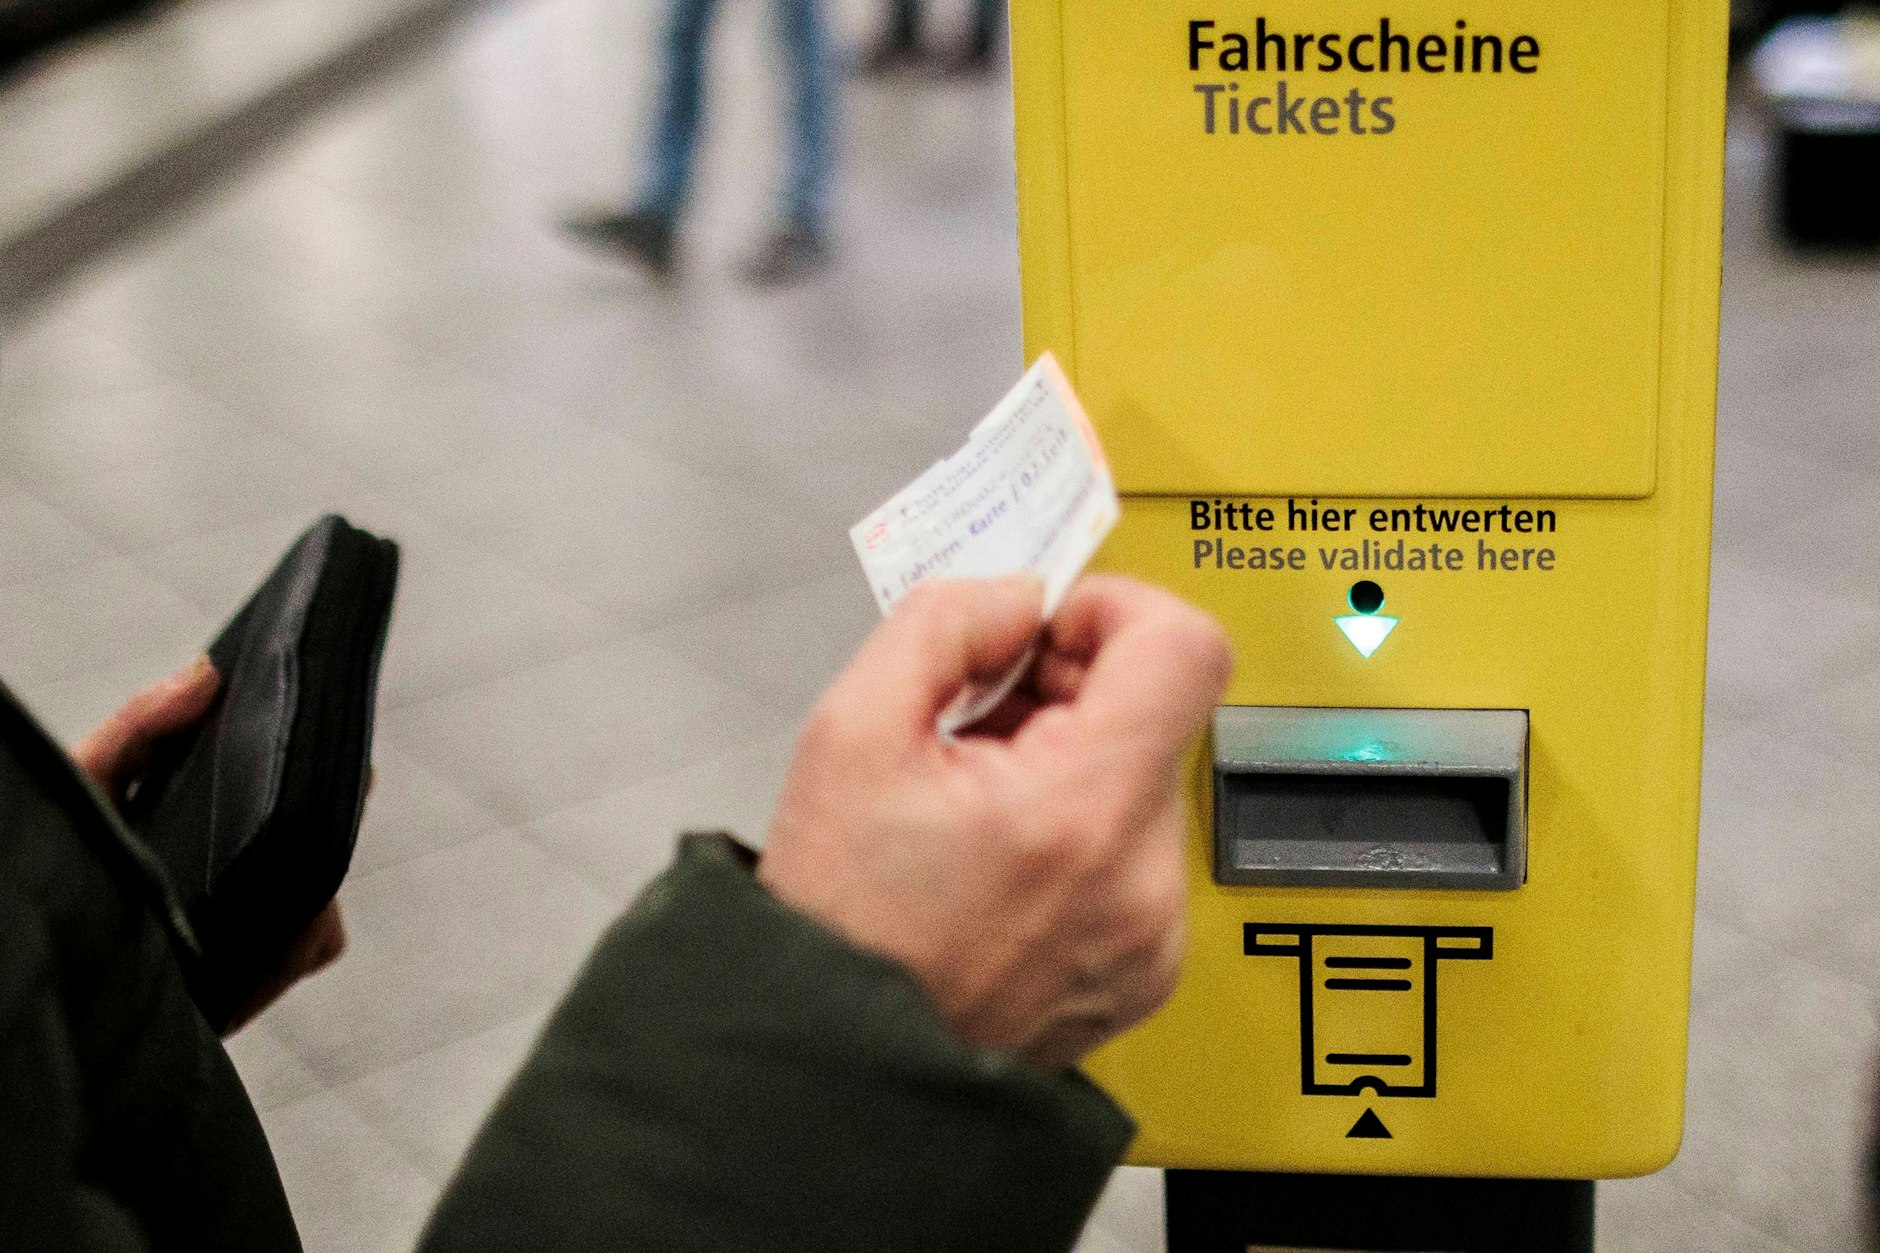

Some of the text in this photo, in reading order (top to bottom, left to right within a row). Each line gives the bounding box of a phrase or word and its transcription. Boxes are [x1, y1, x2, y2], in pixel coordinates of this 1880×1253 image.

[1188, 17, 1541, 74] Fahrscheine
[1195, 81, 1396, 136] Tickets
[968, 499, 1009, 537] Karte
[1188, 497, 1557, 533] Bitte hier entwerten
[1193, 538, 1556, 571] Please validate here
